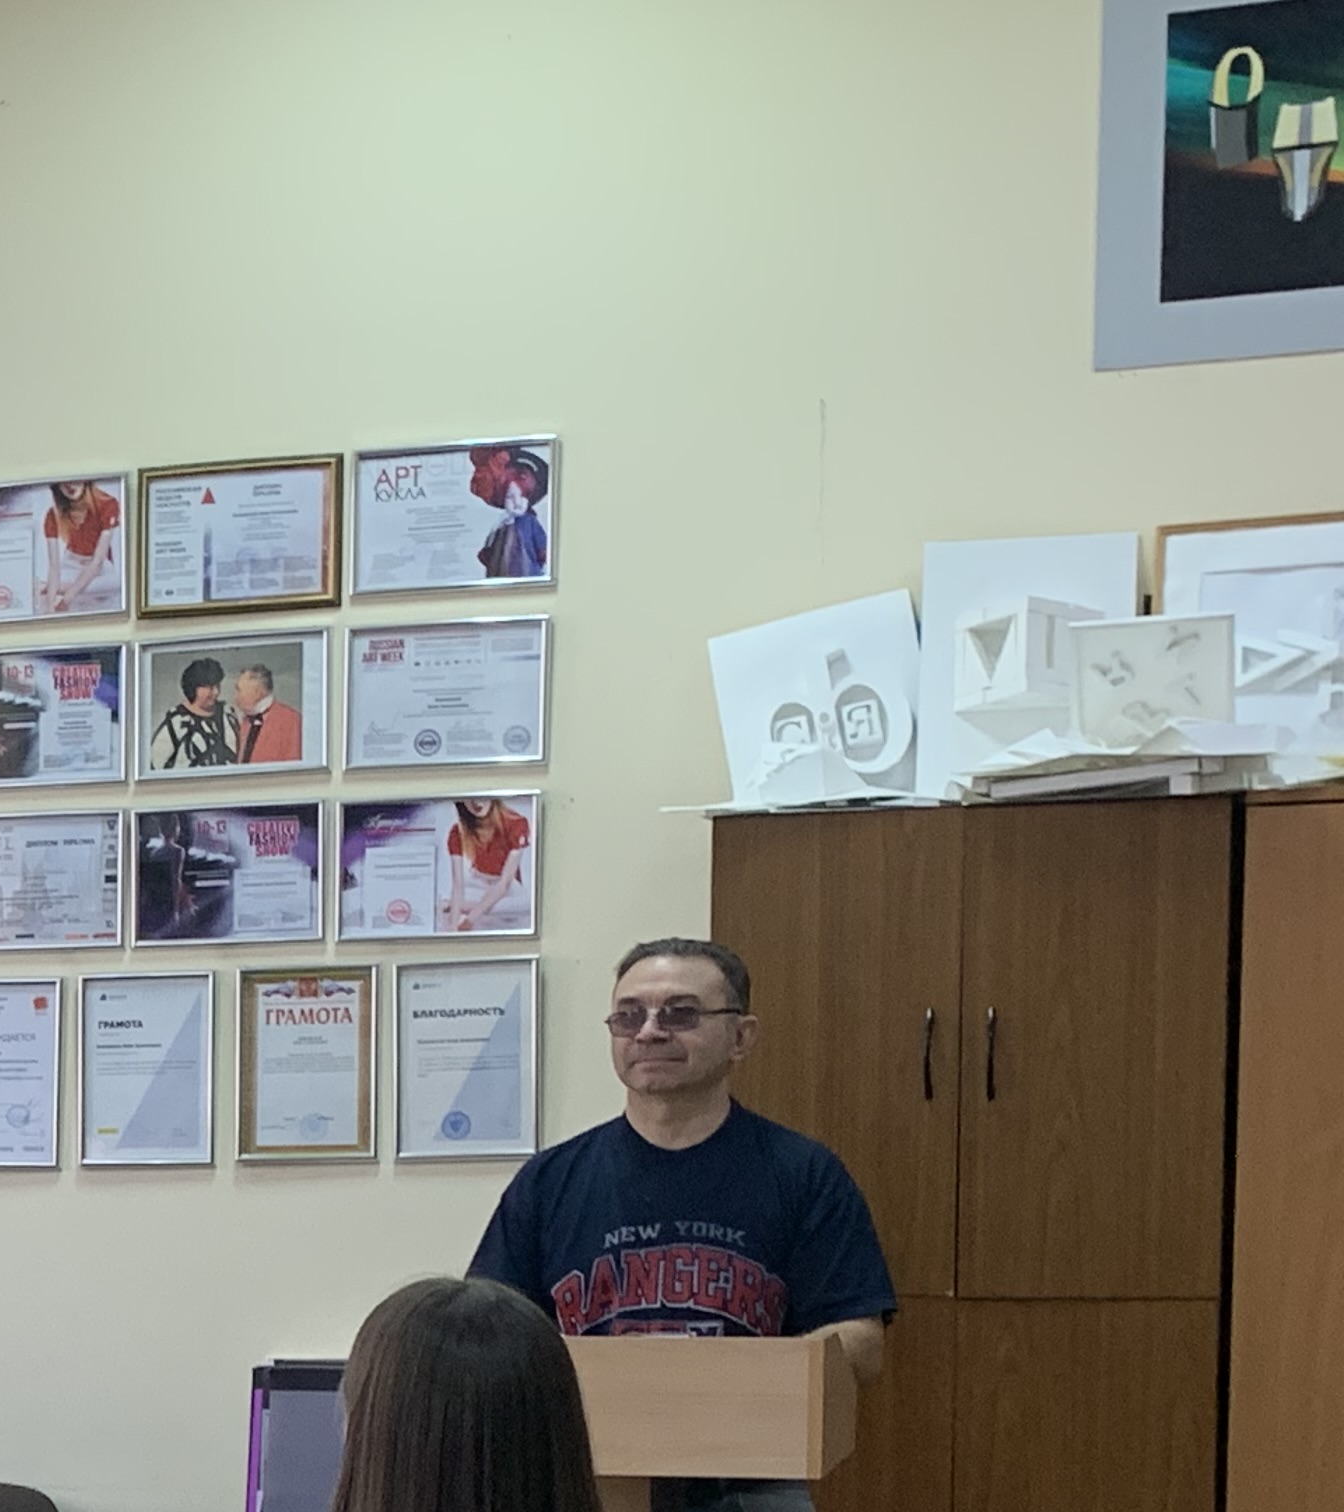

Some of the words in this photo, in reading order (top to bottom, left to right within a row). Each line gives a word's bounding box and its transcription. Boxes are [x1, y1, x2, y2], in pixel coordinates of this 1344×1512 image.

[374, 465, 422, 491] АРТ
[265, 1007, 353, 1025] ГРАМОТА
[413, 1006, 505, 1019] БЛАГОДАРНОСТЬ
[98, 1020, 143, 1029] ГРАМОТА
[604, 1223, 661, 1248] NEW
[675, 1221, 747, 1246] YORK
[551, 1243, 788, 1335] RANGERS
